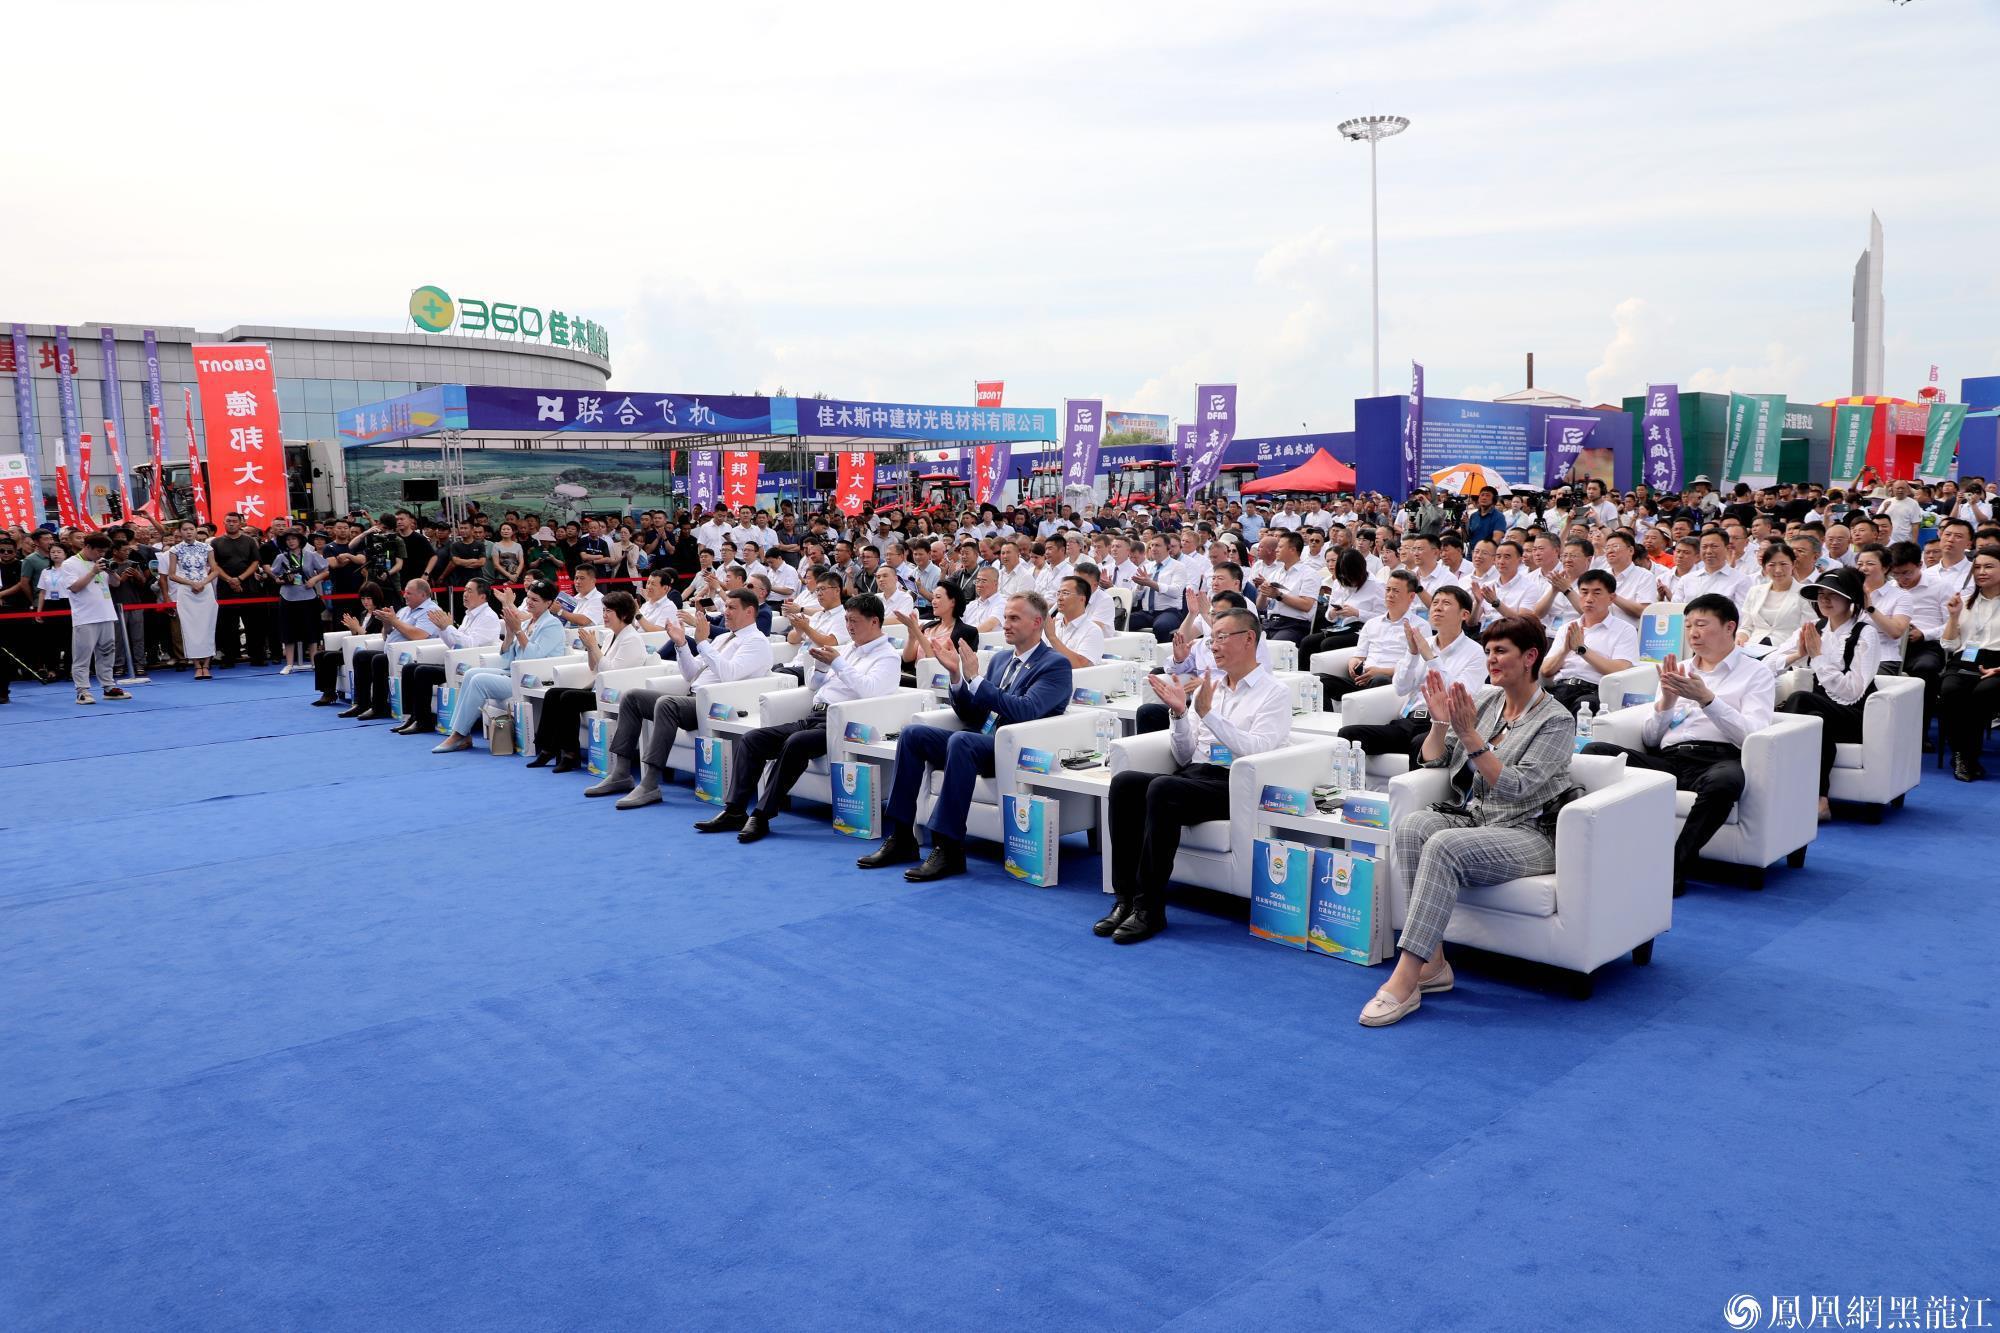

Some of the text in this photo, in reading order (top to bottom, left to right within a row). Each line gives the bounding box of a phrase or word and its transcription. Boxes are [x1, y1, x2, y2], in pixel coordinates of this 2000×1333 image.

[458, 298, 543, 337] 360
[575, 396, 716, 427] 联合飞机
[816, 404, 1046, 433] 佳木斯中建材光电材料有限公司
[1205, 411, 1228, 420] DFAM
[1074, 424, 1094, 432] DFAM
